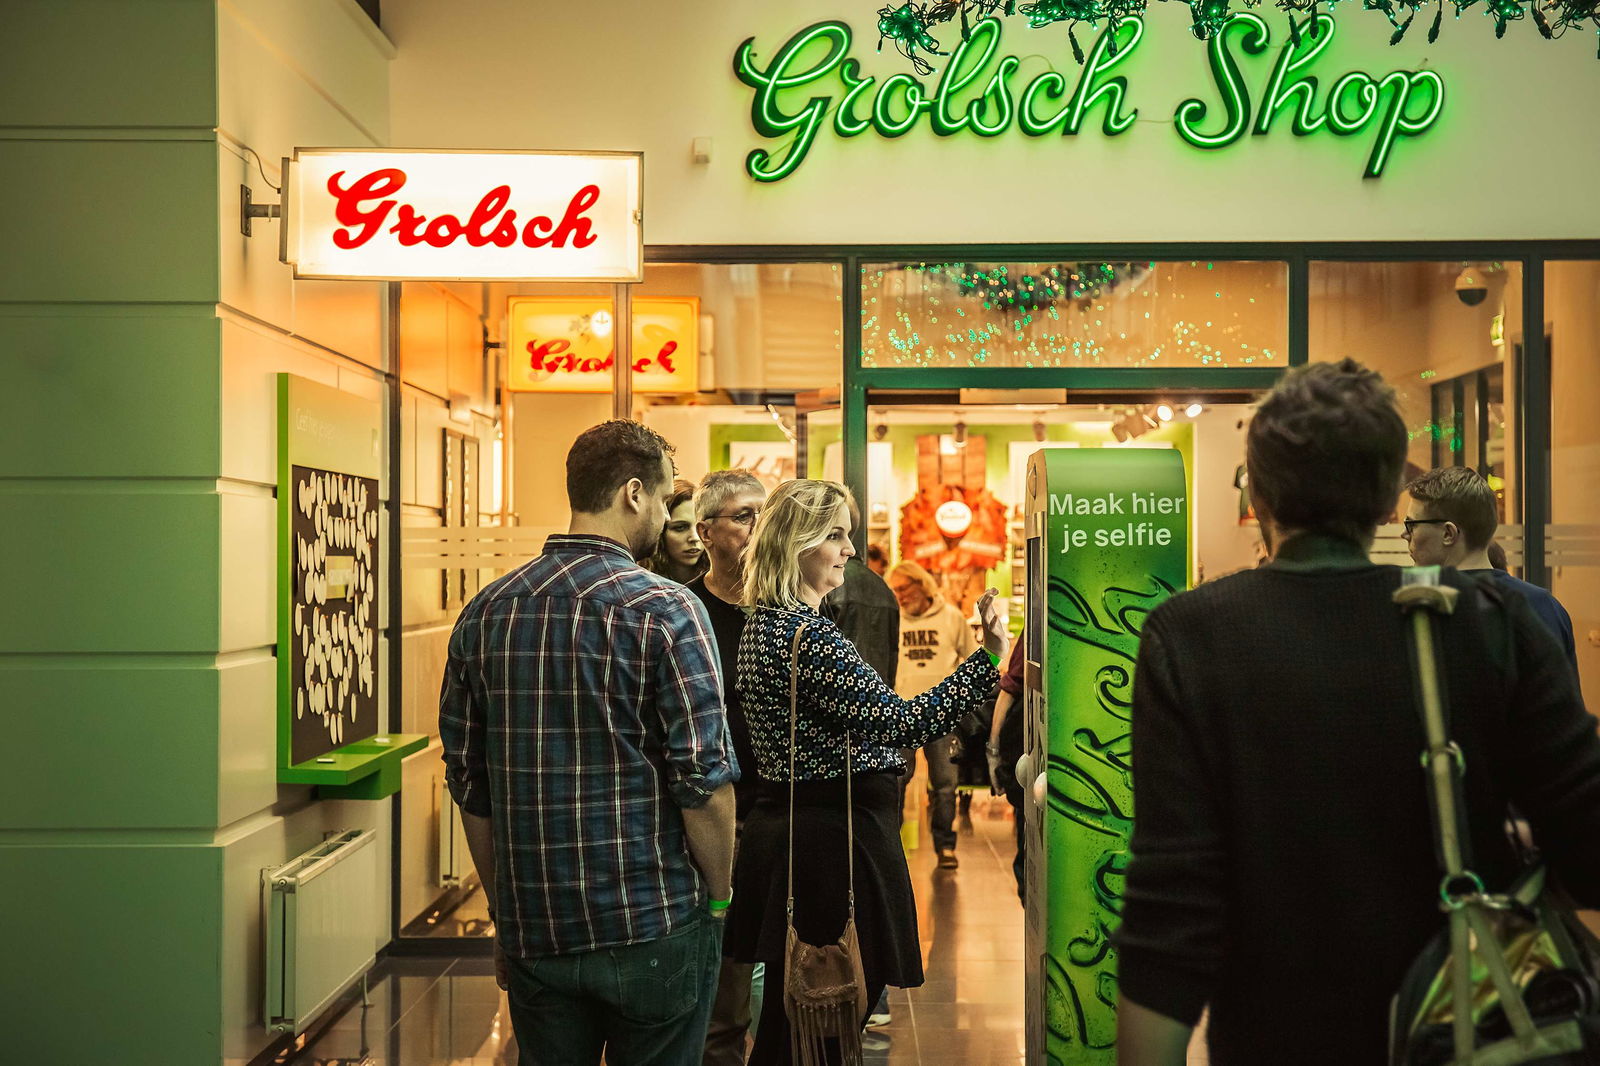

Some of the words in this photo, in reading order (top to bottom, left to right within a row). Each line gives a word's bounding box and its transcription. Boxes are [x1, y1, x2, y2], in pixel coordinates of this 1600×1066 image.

[733, 13, 1138, 183] Grolsch
[1175, 12, 1446, 180] Shop
[327, 168, 601, 250] Grolsch
[1050, 493, 1125, 515] Maak
[1132, 492, 1185, 514] hier
[1061, 524, 1088, 554] je
[1094, 523, 1172, 547] selfie
[902, 630, 939, 647] NIKE
